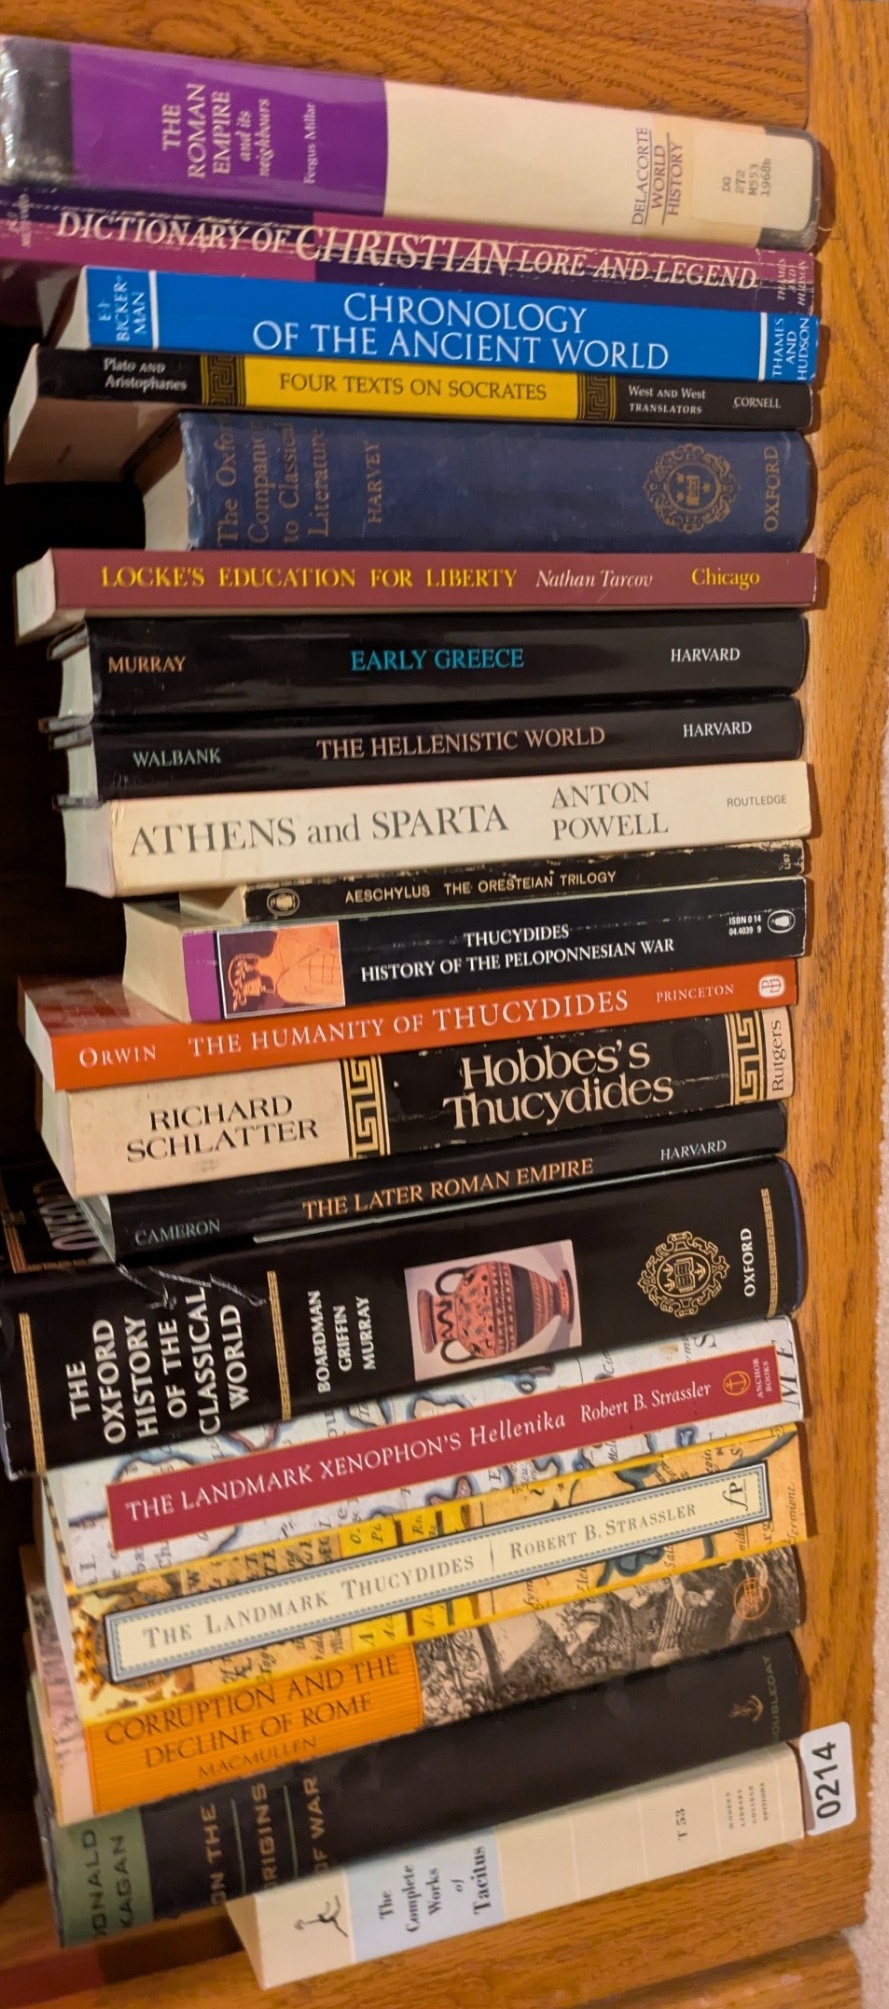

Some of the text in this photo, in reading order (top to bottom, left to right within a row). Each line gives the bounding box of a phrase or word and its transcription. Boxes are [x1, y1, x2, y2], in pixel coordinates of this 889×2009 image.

[162, 103, 182, 151] THE
[187, 82, 206, 179] ROMAN
[212, 90, 231, 175] EMPIRE
[238, 109, 252, 163] and its
[257, 98, 275, 178] neighbours
[303, 102, 317, 185] Fergus Millar
[631, 126, 651, 226] DELACORTE
[650, 143, 665, 210] WORLD
[666, 141, 683, 217] HISTORY
[721, 175, 732, 194] DG
[734, 168, 746, 195] 272
[56, 210, 250, 252] DICTIONARY
[251, 228, 292, 253] OF
[296, 224, 515, 277] CHRISTIAN
[517, 248, 587, 278] LORE
[593, 256, 650, 282] AND
[653, 262, 759, 291] LEGEND
[775, 257, 788, 302] THAMES
[132, 290, 146, 336] MAN
[343, 292, 588, 334] CHRONOLOGY
[103, 357, 166, 375] Plato AND
[252, 320, 670, 371] OF THE ANCIENT WORLD
[771, 317, 785, 378] THAMES
[785, 329, 797, 366] AND
[796, 316, 810, 381] HUDSON
[104, 373, 188, 393] Aristophanes
[279, 372, 547, 401] FOUR TEXTS ON SOCRATES
[628, 384, 706, 401] West AND West
[628, 401, 703, 415] TRANSLATORS
[735, 396, 782, 410] CORNELL
[274, 421, 301, 545] to Classical
[307, 428, 331, 539] Literature
[364, 440, 383, 525] HARVEY
[763, 445, 781, 533] OXFORD
[216, 496, 239, 544] The
[101, 566, 761, 591] LOCKE'S EDUCATION FOR LIBERTY Nathan Tarcov Chicago
[107, 647, 741, 674] MURRAY EARLY GREECE HARVARD
[132, 720, 753, 768] WALBANK THE HELLENISTIC WORLD HARVARD
[550, 780, 651, 810] ANTON
[726, 794, 788, 808] ROUTLEDGE
[129, 803, 511, 857] ATHENS and SPARTA
[552, 812, 670, 842] POWELL
[344, 870, 617, 905] AESCHYLUS THE ORESTEIAN TRILOGY
[463, 923, 570, 948] THUCYDIDES
[728, 915, 747, 926] ISBN
[360, 937, 676, 984] HISTORY OF THE PELOPONNESIAN WAR
[78, 983, 735, 1070] ORWIN THE HUMANITY OF THUCYDIDES PRINCETON
[462, 1041, 651, 1091] Hobbes's
[770, 1020, 788, 1093] Rutgers
[149, 1094, 293, 1133] RICHARD
[442, 1073, 675, 1131] Thucydides
[126, 1118, 321, 1164] SCHLATTER
[134, 1138, 728, 1247] CAMERON THE LATER ROMAN EMPIRE HARVARD
[739, 1227, 757, 1298] OXFORD
[184, 1286, 222, 1437] CLASSICAL
[218, 1303, 251, 1411] WORLD
[307, 1289, 332, 1394] BOARDMAN
[332, 1304, 353, 1373] GRIFFIN
[354, 1295, 377, 1371] MURRAY
[65, 1359, 93, 1421] THE
[92, 1319, 127, 1446] OXFORD
[123, 1314, 160, 1440] HISTORY
[156, 1318, 189, 1419] OF THE
[752, 1357, 765, 1400] ANCHOR
[762, 1359, 773, 1393] BOOKS
[125, 1493, 175, 1522] THE
[180, 1464, 313, 1512] LANDMARK
[319, 1432, 463, 1480] XENOPHON'S
[468, 1411, 567, 1448] Hellenika
[579, 1399, 630, 1424] Robert
[632, 1393, 649, 1412] B.
[650, 1380, 712, 1409] Strassler
[141, 1621, 194, 1651] THE
[205, 1591, 331, 1636] LANDMARK
[340, 1553, 476, 1602] THUCYDIDES
[508, 1530, 579, 1561] ROBERT
[584, 1522, 602, 1541] B.
[605, 1502, 697, 1538] STRASSLER
[104, 1684, 276, 1747] CORRUPTION
[287, 1669, 345, 1699] AND
[347, 1652, 399, 1679] THE
[143, 1691, 373, 1770] DECLINE OF ROME
[198, 1735, 318, 1780] MACMULLEN
[303, 1775, 327, 1836] WAR
[811, 1741, 842, 1820] 0214
[200, 1802, 222, 1865] THE
[677, 1829, 688, 1841] T
[110, 1833, 135, 1930] KAGAN
[377, 1889, 395, 1921] The
[402, 1863, 422, 1933] Complete
[425, 1866, 443, 1916] Works
[450, 1878, 465, 1893] of
[470, 1845, 492, 1915] Tacitus
